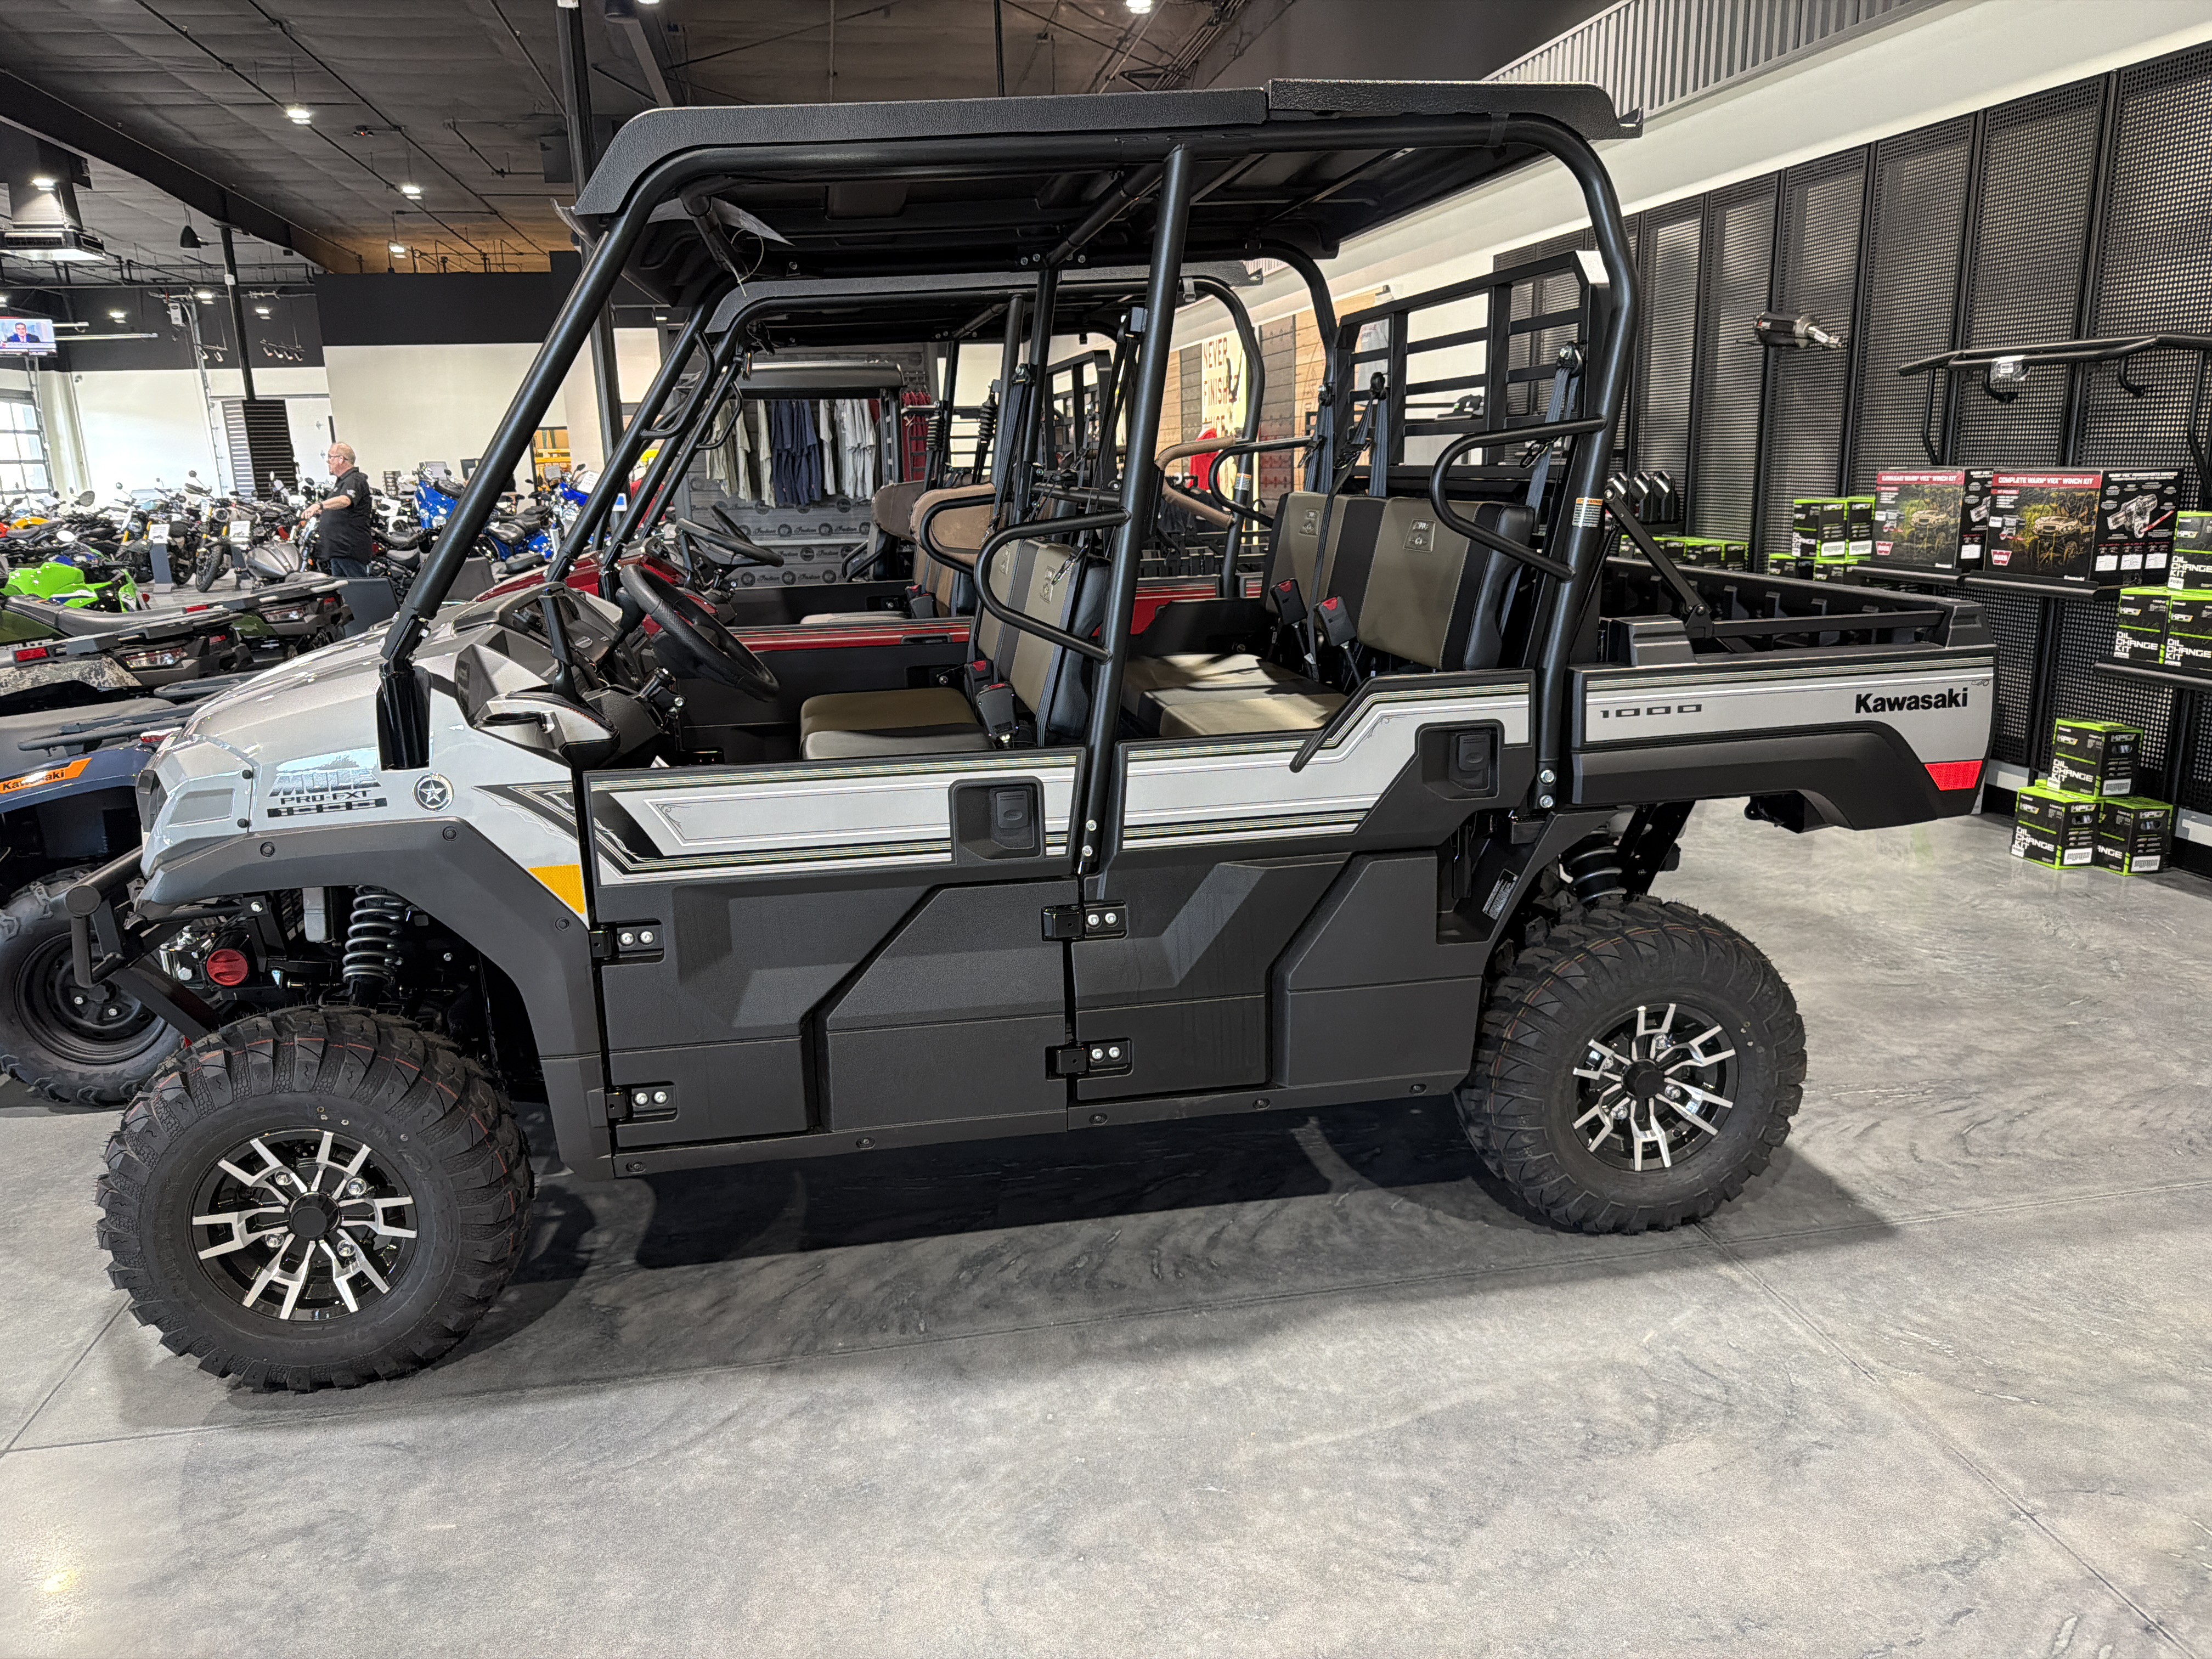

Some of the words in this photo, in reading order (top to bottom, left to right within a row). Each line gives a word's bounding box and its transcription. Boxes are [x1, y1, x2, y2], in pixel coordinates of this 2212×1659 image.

[1204, 337, 1228, 370] NEVER
[2172, 555, 2188, 563] OIL
[2171, 562, 2212, 573] CHANGE
[2170, 569, 2186, 578] KIT
[2116, 631, 2132, 640] OIL
[2115, 638, 2159, 651] CHANGE
[2166, 638, 2184, 647] OIL
[2114, 645, 2131, 653] KIT
[2166, 645, 2212, 658] CHANGE
[2165, 652, 2183, 661] KIT
[1855, 687, 1968, 714] Kawasaki
[1600, 704, 1702, 719] 1000
[2053, 759, 2068, 769] OIL
[2051, 772, 2067, 782] KIT
[2052, 765, 2094, 783] CHANGE
[268, 769, 382, 798] MULE
[280, 789, 372, 805] PRO-FXT
[279, 800, 376, 816] 1000
[2016, 826, 2031, 837] OIL
[2015, 833, 2055, 852] CHANGE
[2015, 840, 2030, 850] KIT
